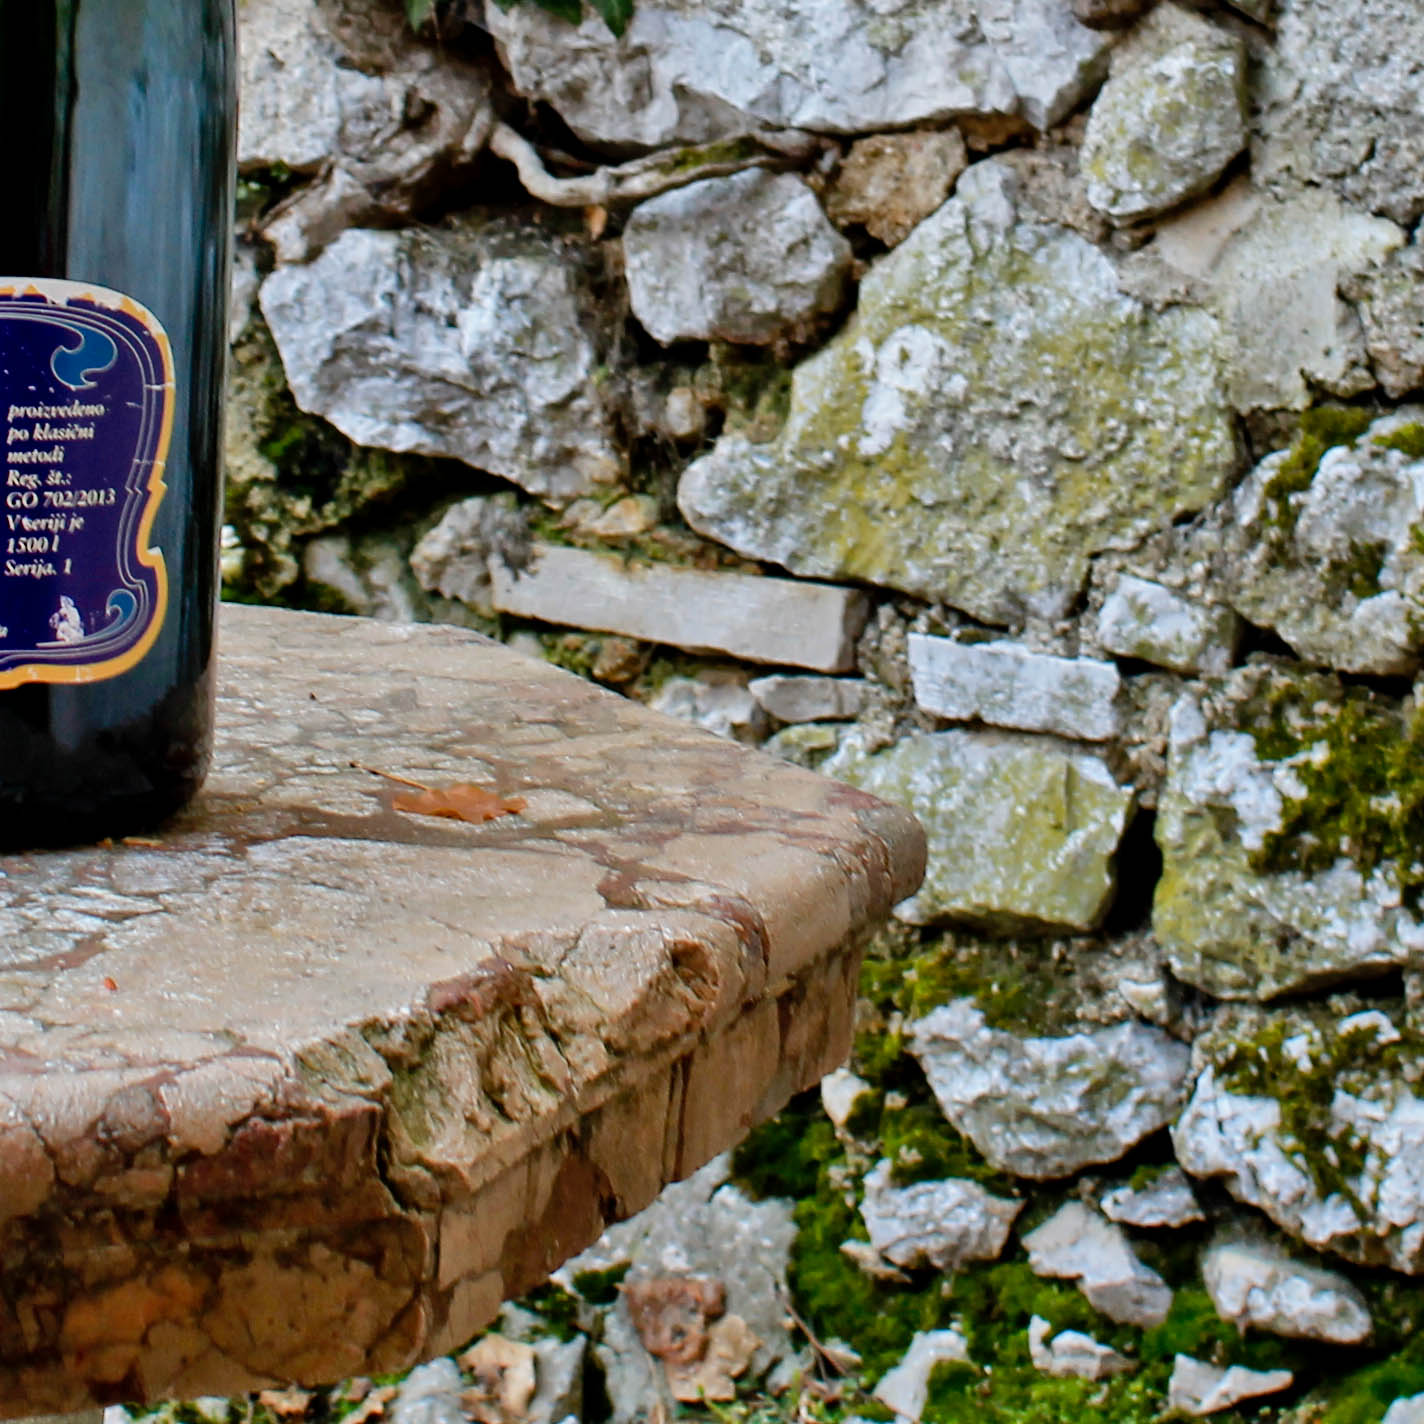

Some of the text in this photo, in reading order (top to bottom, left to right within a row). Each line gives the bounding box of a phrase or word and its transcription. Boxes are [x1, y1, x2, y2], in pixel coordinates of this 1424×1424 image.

[7, 400, 105, 424] proizvedeno
[6, 422, 96, 446] po klasični
[6, 444, 65, 464] metodi
[6, 469, 42, 490] Reg.
[6, 488, 116, 509] GO 702/2013
[6, 514, 22, 532] V
[68, 512, 85, 534] je
[6, 536, 49, 554] 1500
[64, 558, 72, 575] 1
